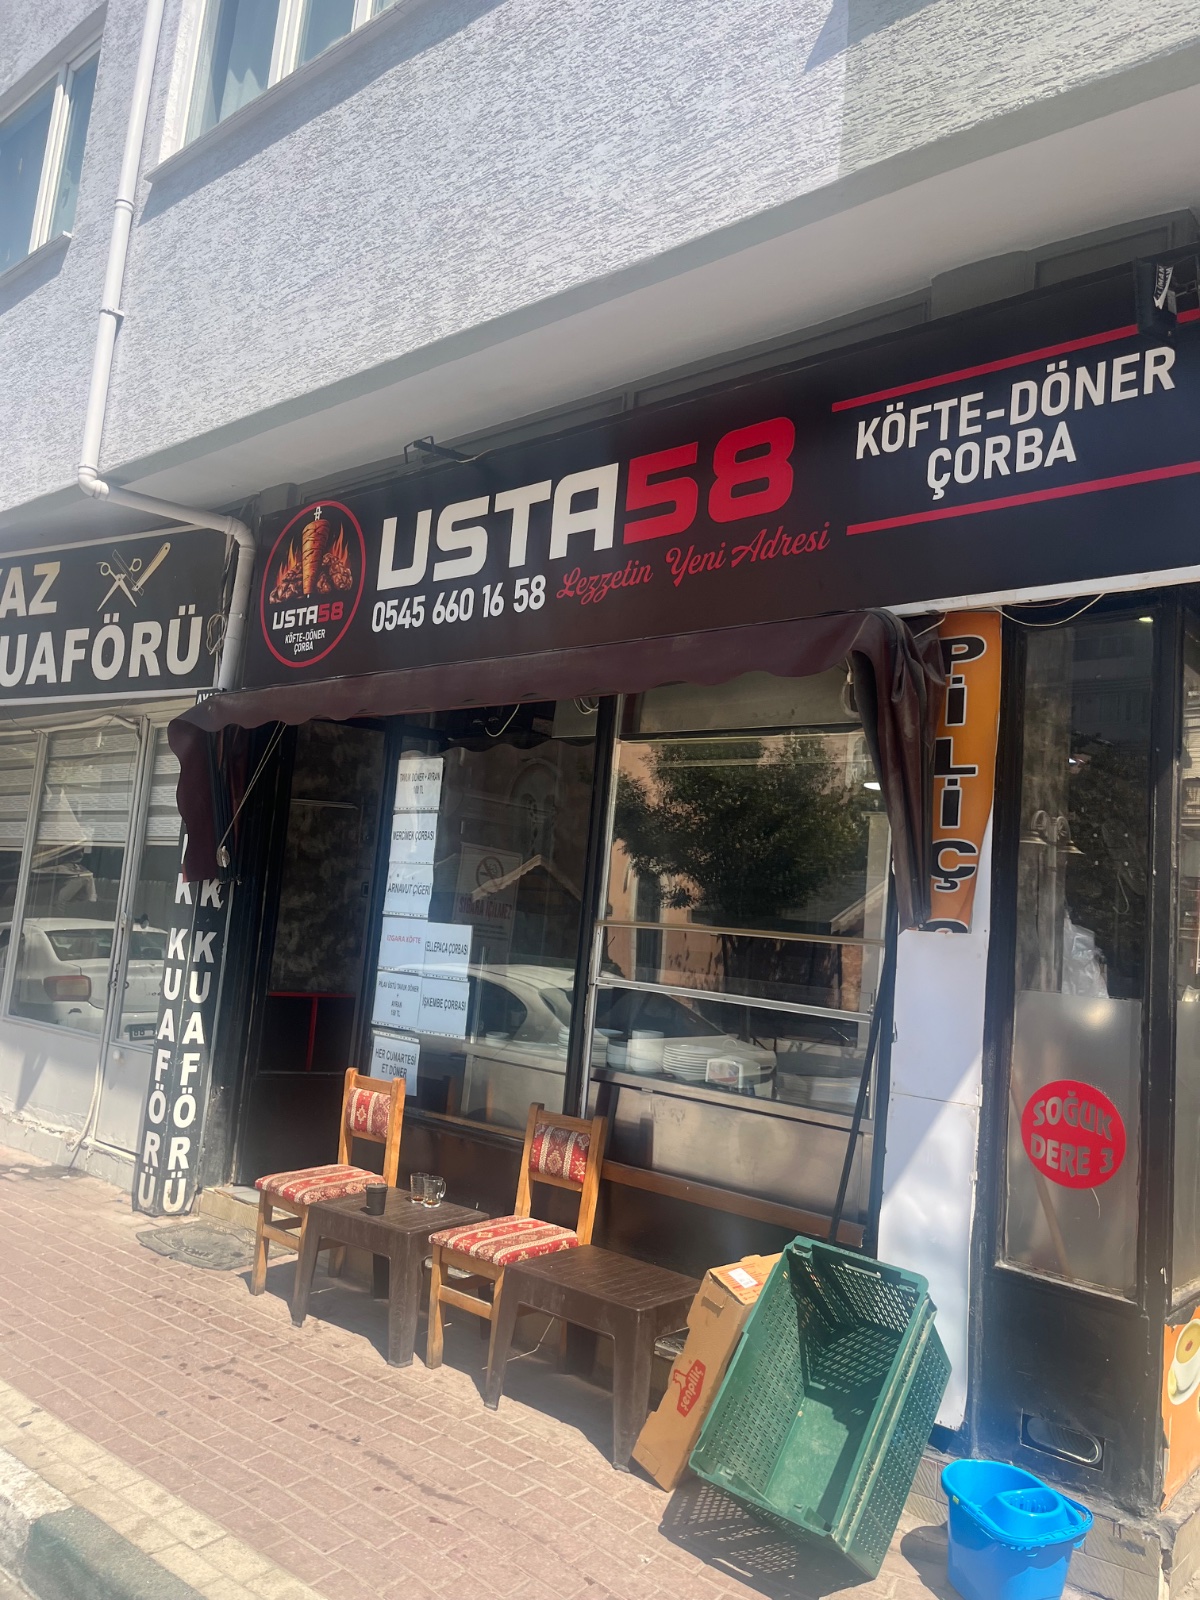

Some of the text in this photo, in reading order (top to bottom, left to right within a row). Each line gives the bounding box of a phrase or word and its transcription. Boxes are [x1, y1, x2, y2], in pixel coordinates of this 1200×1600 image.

[856, 346, 1176, 460] KÖFTE-DÖNER
[927, 421, 1077, 501] ÇORBA
[376, 416, 796, 591] USTA58
[556, 521, 831, 605] Lezzetin Yeni Adresi
[0, 561, 61, 618] AZ
[371, 574, 547, 633] 0545 660 16 58
[272, 601, 344, 630] USTA58
[285, 628, 326, 645] KÖFTE-DÖNER
[293, 641, 314, 656] ÇORBA
[415, 830, 435, 843] ÇORBASI
[387, 883, 412, 894] ARNAVUT
[444, 998, 467, 1011] ÇORBASI
[138, 928, 189, 1208] KUAFÖRÜ
[162, 931, 217, 1212] KUAFÖRÜ
[375, 1048, 417, 1066] HER CUMARTESİ
[381, 1063, 408, 1078] ET DÖNER
[1032, 1090, 1113, 1142] SOĞUK
[1030, 1133, 1114, 1178] DERE 3
